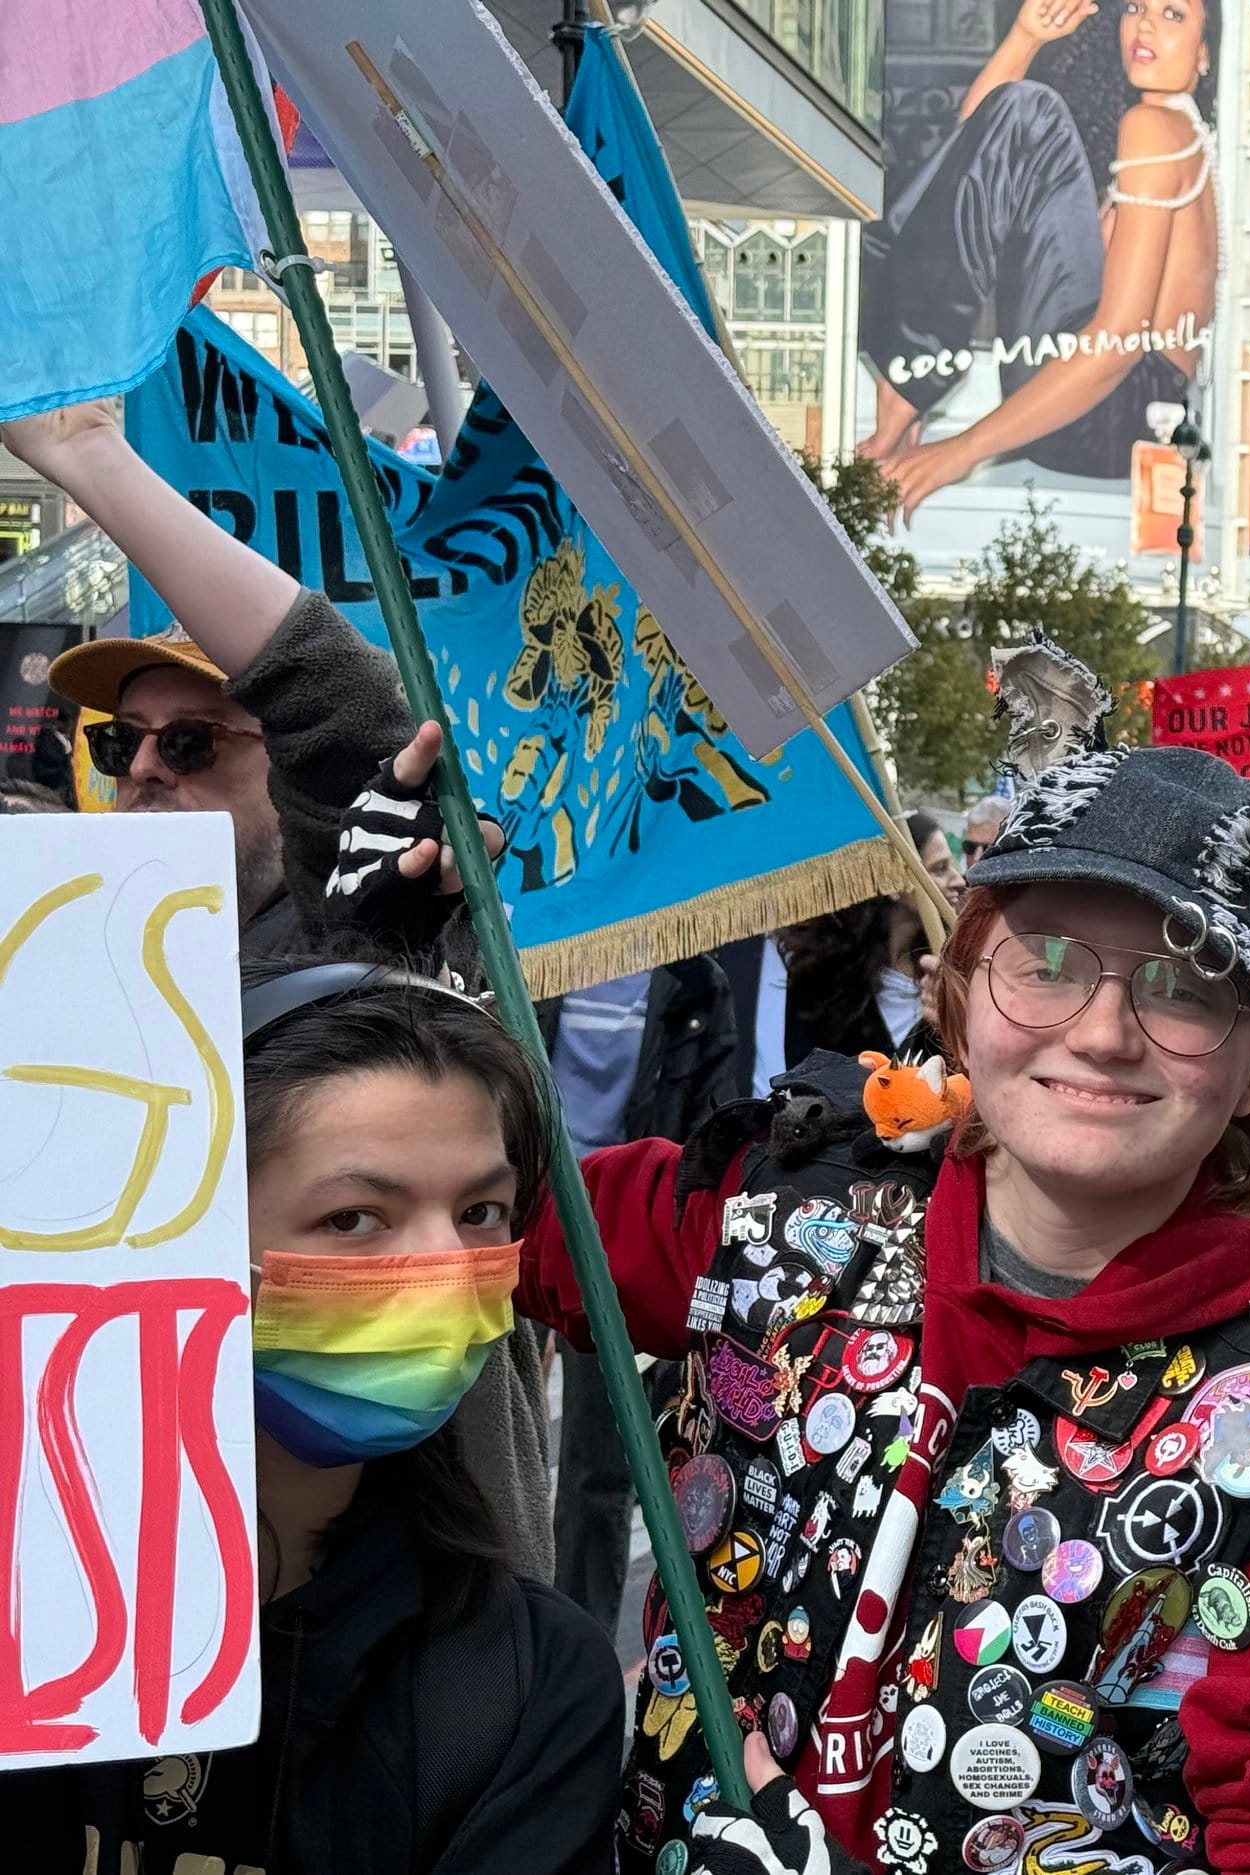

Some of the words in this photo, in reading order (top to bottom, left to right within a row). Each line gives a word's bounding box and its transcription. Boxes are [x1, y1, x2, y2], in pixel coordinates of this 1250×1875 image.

[1168, 706, 1228, 734] OUR
[686, 1315, 707, 1332] LIKES
[748, 1465, 777, 1486] BLACK
[747, 1480, 774, 1499] LIVES
[743, 1491, 776, 1515] MATTER
[774, 1510, 798, 1531] ART
[770, 1524, 792, 1545] NOT
[718, 1566, 737, 1586] NYC
[1196, 1621, 1219, 1647] Death
[1049, 1695, 1087, 1718] TEACH
[1034, 1717, 1081, 1742] HISTORY
[1040, 1706, 1086, 1732] BANNED
[970, 1749, 1021, 1757] VACCINES,
[986, 1740, 1011, 1748] LOVE
[967, 1766, 1026, 1774] ABORTIONS,
[975, 1757, 1016, 1765] AUTISM,
[958, 1774, 1034, 1782] HOMOSEXUALS,
